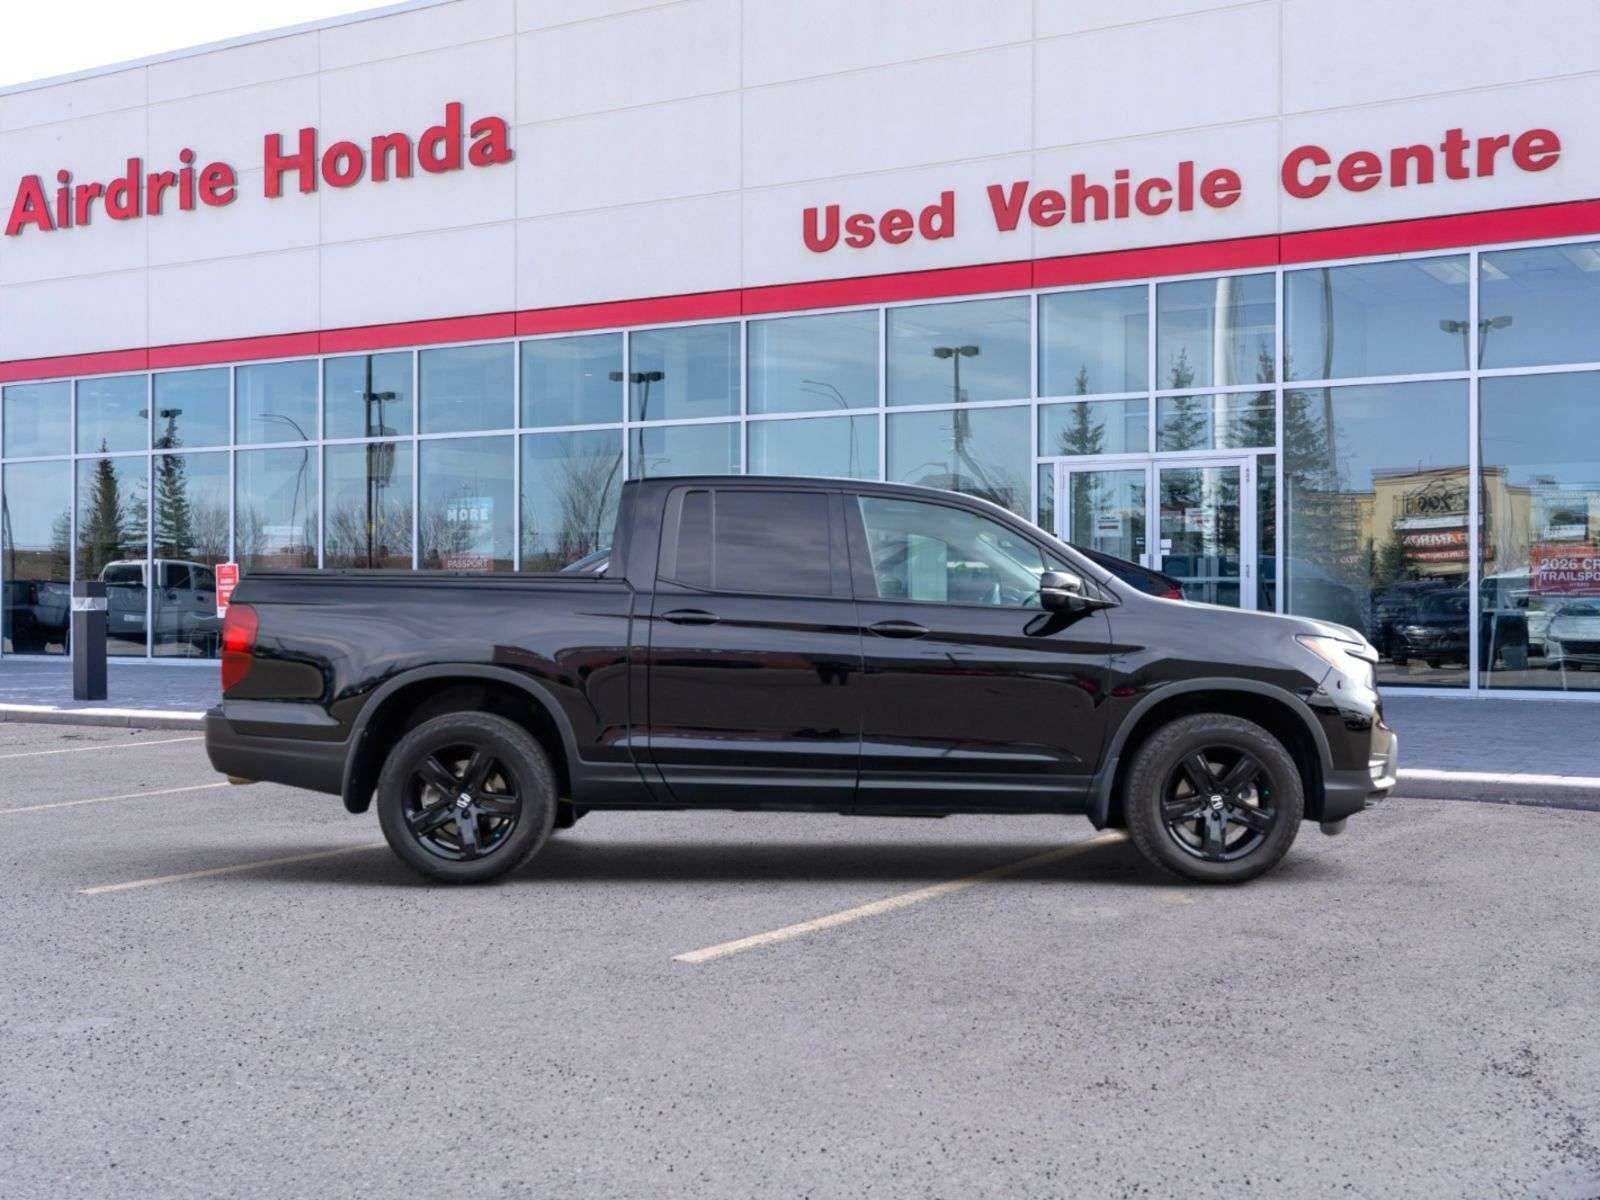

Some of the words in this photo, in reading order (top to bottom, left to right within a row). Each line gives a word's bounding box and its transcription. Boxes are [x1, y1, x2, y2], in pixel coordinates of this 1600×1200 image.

[6, 148, 236, 236] Airdrie
[264, 102, 514, 198] Honda
[803, 191, 955, 253] Used
[987, 162, 1241, 232] Vehicle
[1281, 128, 1561, 199] Centre
[447, 508, 489, 521] MORE
[447, 559, 489, 569] PASSPORT
[1541, 558, 1578, 570] 2026
